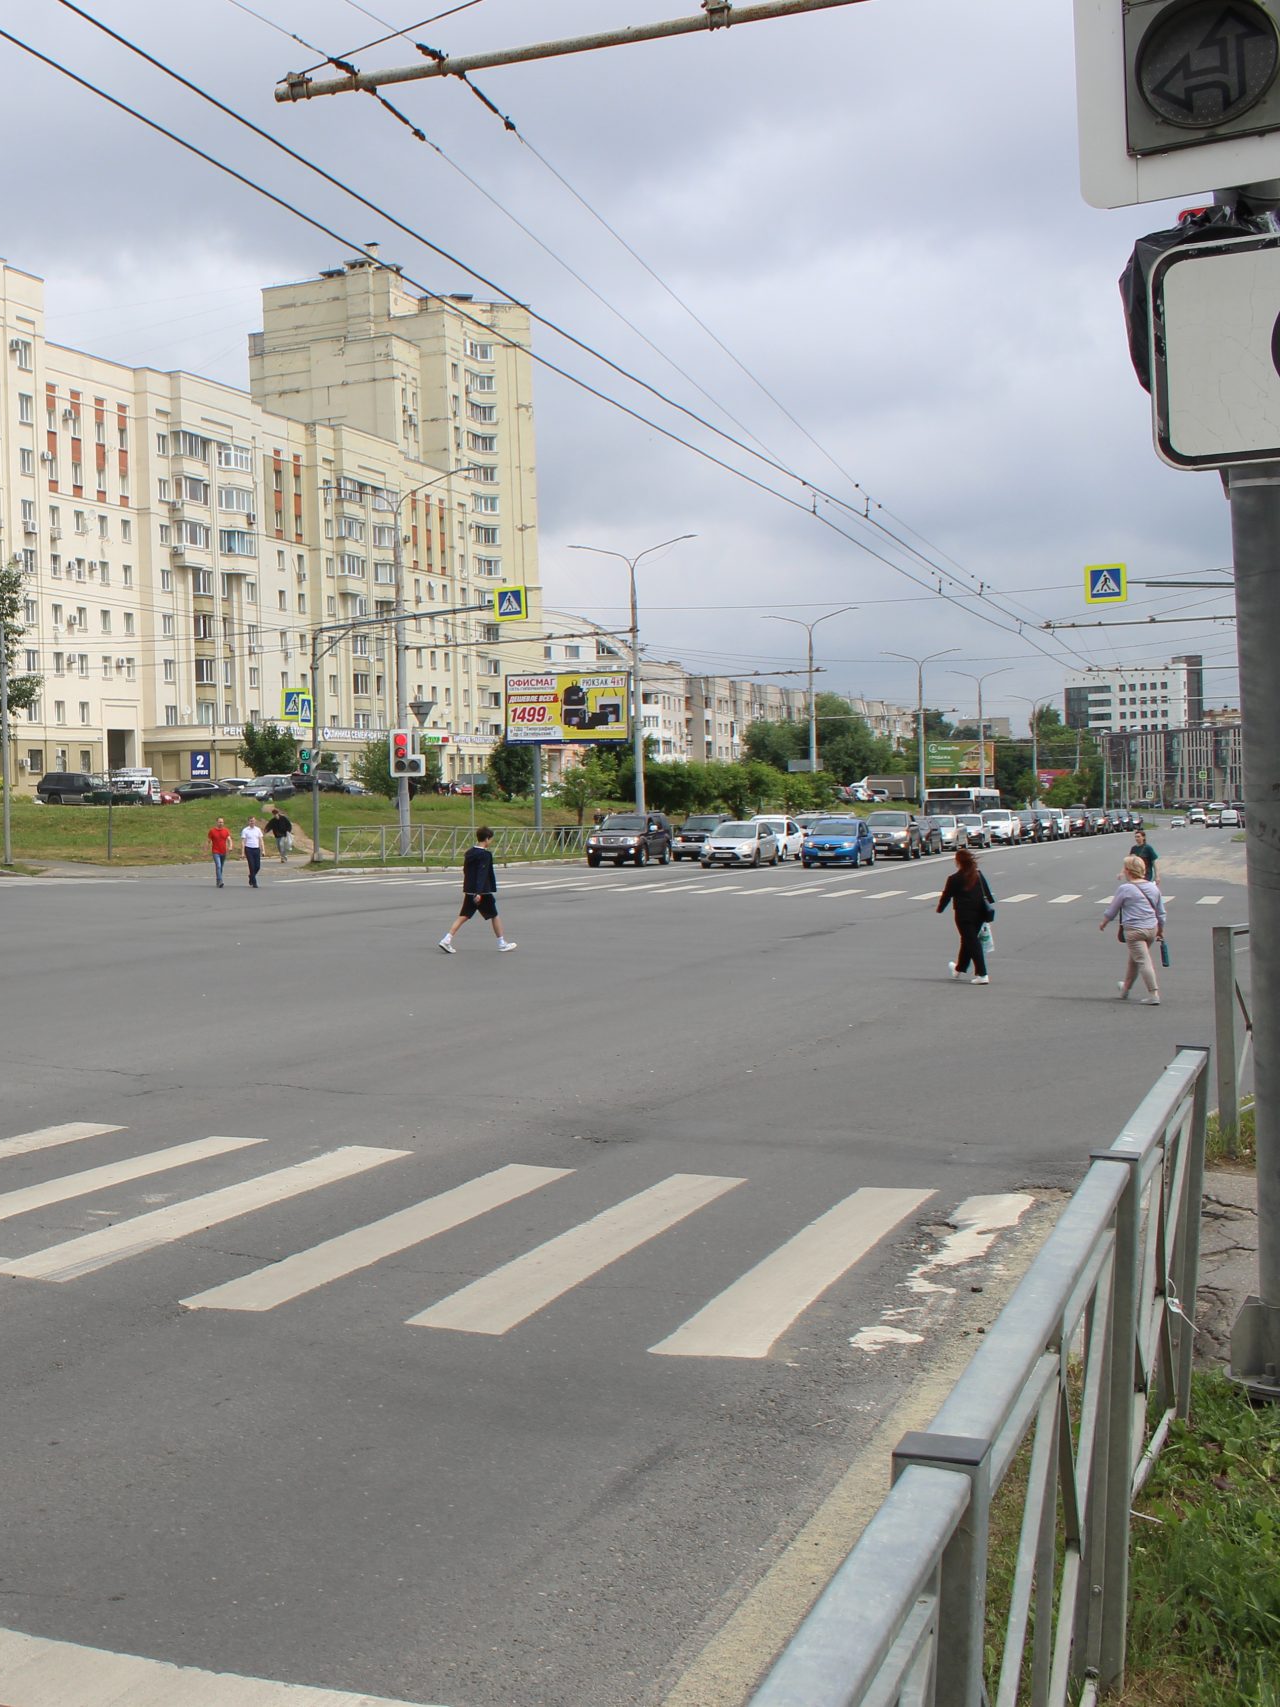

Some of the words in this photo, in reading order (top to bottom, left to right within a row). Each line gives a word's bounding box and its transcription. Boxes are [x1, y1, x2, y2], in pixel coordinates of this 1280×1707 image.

[508, 678, 555, 687] ОФИСМАГ
[582, 678, 609, 687] РЮКЗАК
[508, 695, 538, 704] ДЕШЕВЛЕ
[539, 694, 554, 703] ВСЕХ
[510, 706, 547, 723] 1499
[196, 754, 205, 768] 2
